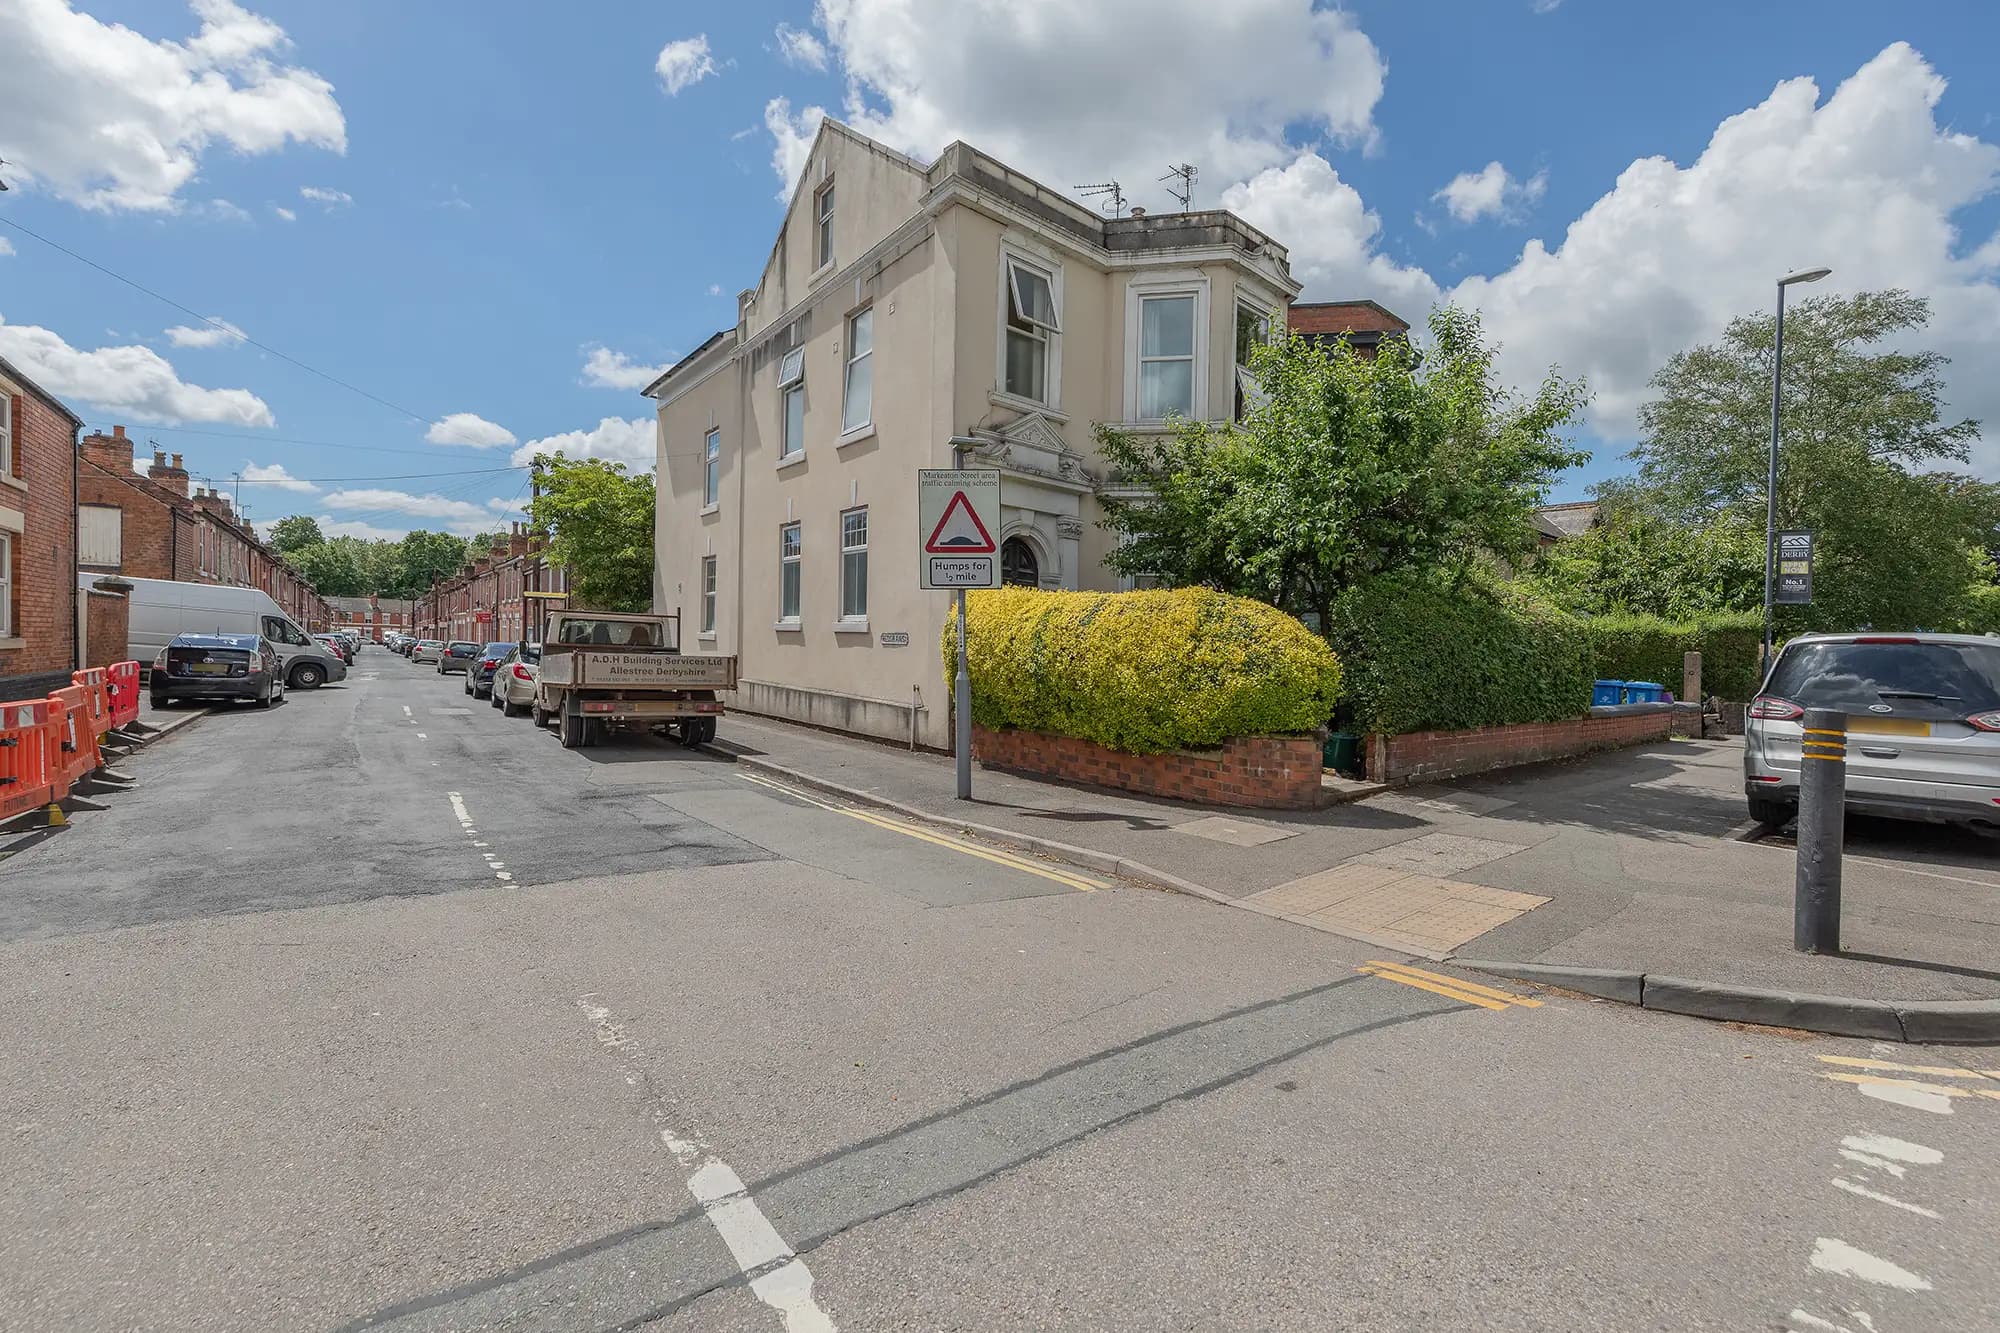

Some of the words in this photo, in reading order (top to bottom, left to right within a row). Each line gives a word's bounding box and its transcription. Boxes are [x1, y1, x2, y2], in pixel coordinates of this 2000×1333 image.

[944, 480, 971, 488] calming
[935, 562, 970, 572] Humps
[972, 561, 987, 570] for
[955, 572, 978, 581] mile
[592, 656, 620, 664] A.D.H
[623, 656, 662, 666] Building
[664, 656, 706, 666] Services
[708, 657, 722, 666] Ltd
[610, 666, 654, 676] Allestree
[656, 667, 706, 678] Derbyshire
